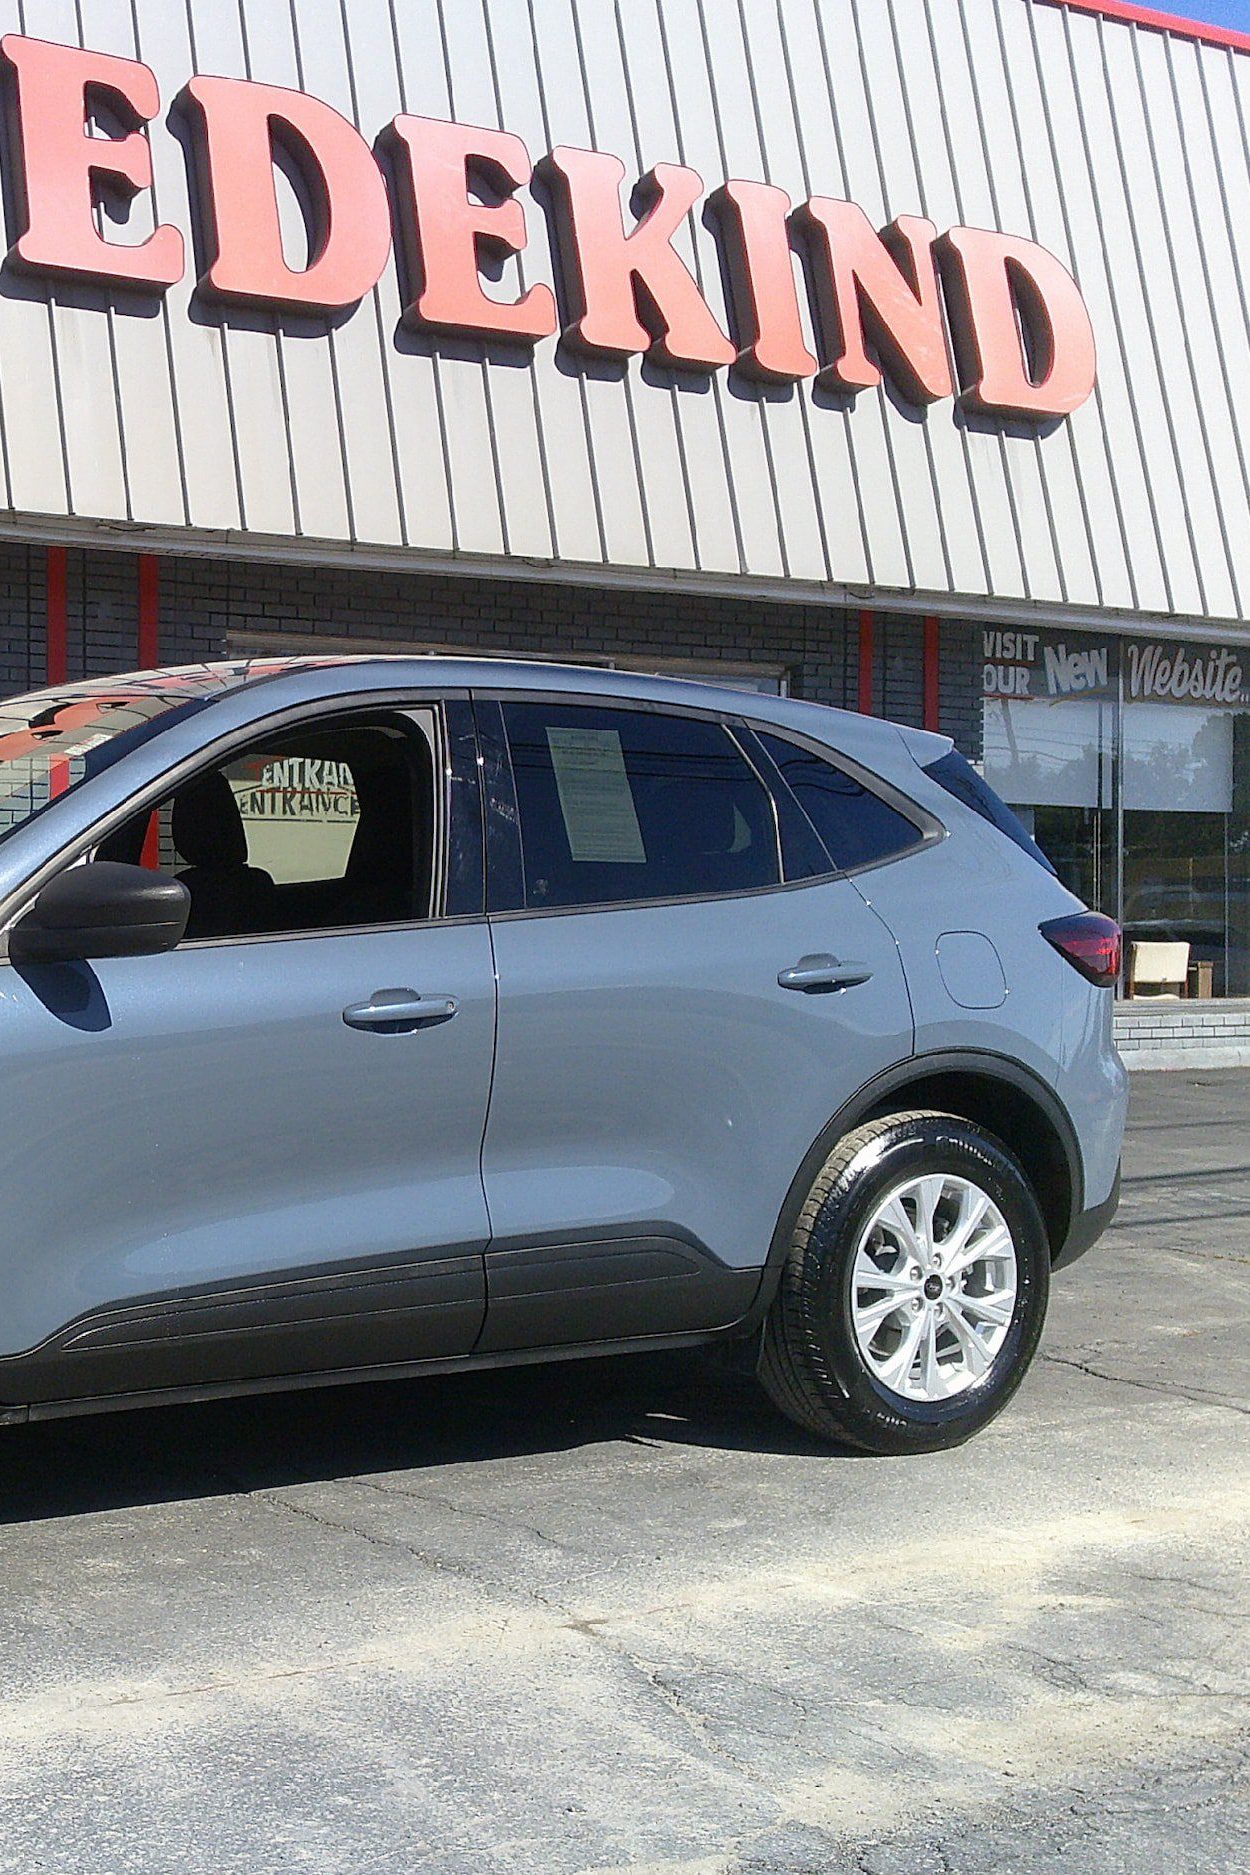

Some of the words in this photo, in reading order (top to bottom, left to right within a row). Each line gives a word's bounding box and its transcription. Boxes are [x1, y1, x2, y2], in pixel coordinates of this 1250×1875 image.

[982, 631, 1039, 661] VISIT
[982, 664, 1030, 694] OUR
[1044, 643, 1108, 695] New
